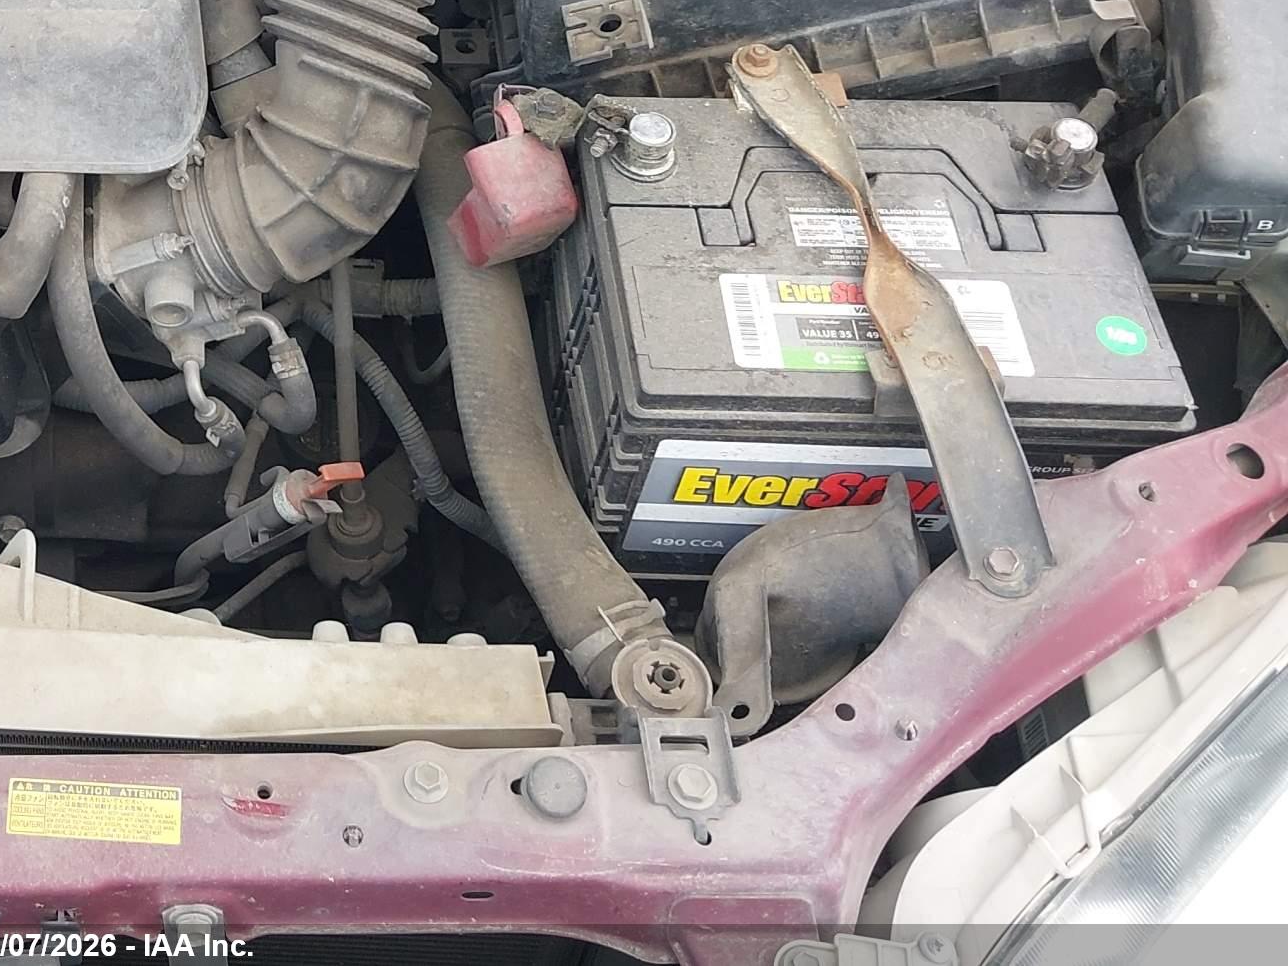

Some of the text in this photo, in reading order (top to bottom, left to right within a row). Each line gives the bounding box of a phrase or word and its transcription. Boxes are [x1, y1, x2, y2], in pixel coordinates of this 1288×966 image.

[1256, 219, 1275, 231] B
[776, 279, 866, 305] EverSt
[802, 329, 852, 339] VALUE 35
[866, 331, 881, 339] 49
[672, 465, 946, 512] EverSt
[651, 537, 725, 549] 490 CCA
[59, 784, 111, 795] CAUTION
[120, 788, 177, 800] ATTENTION
